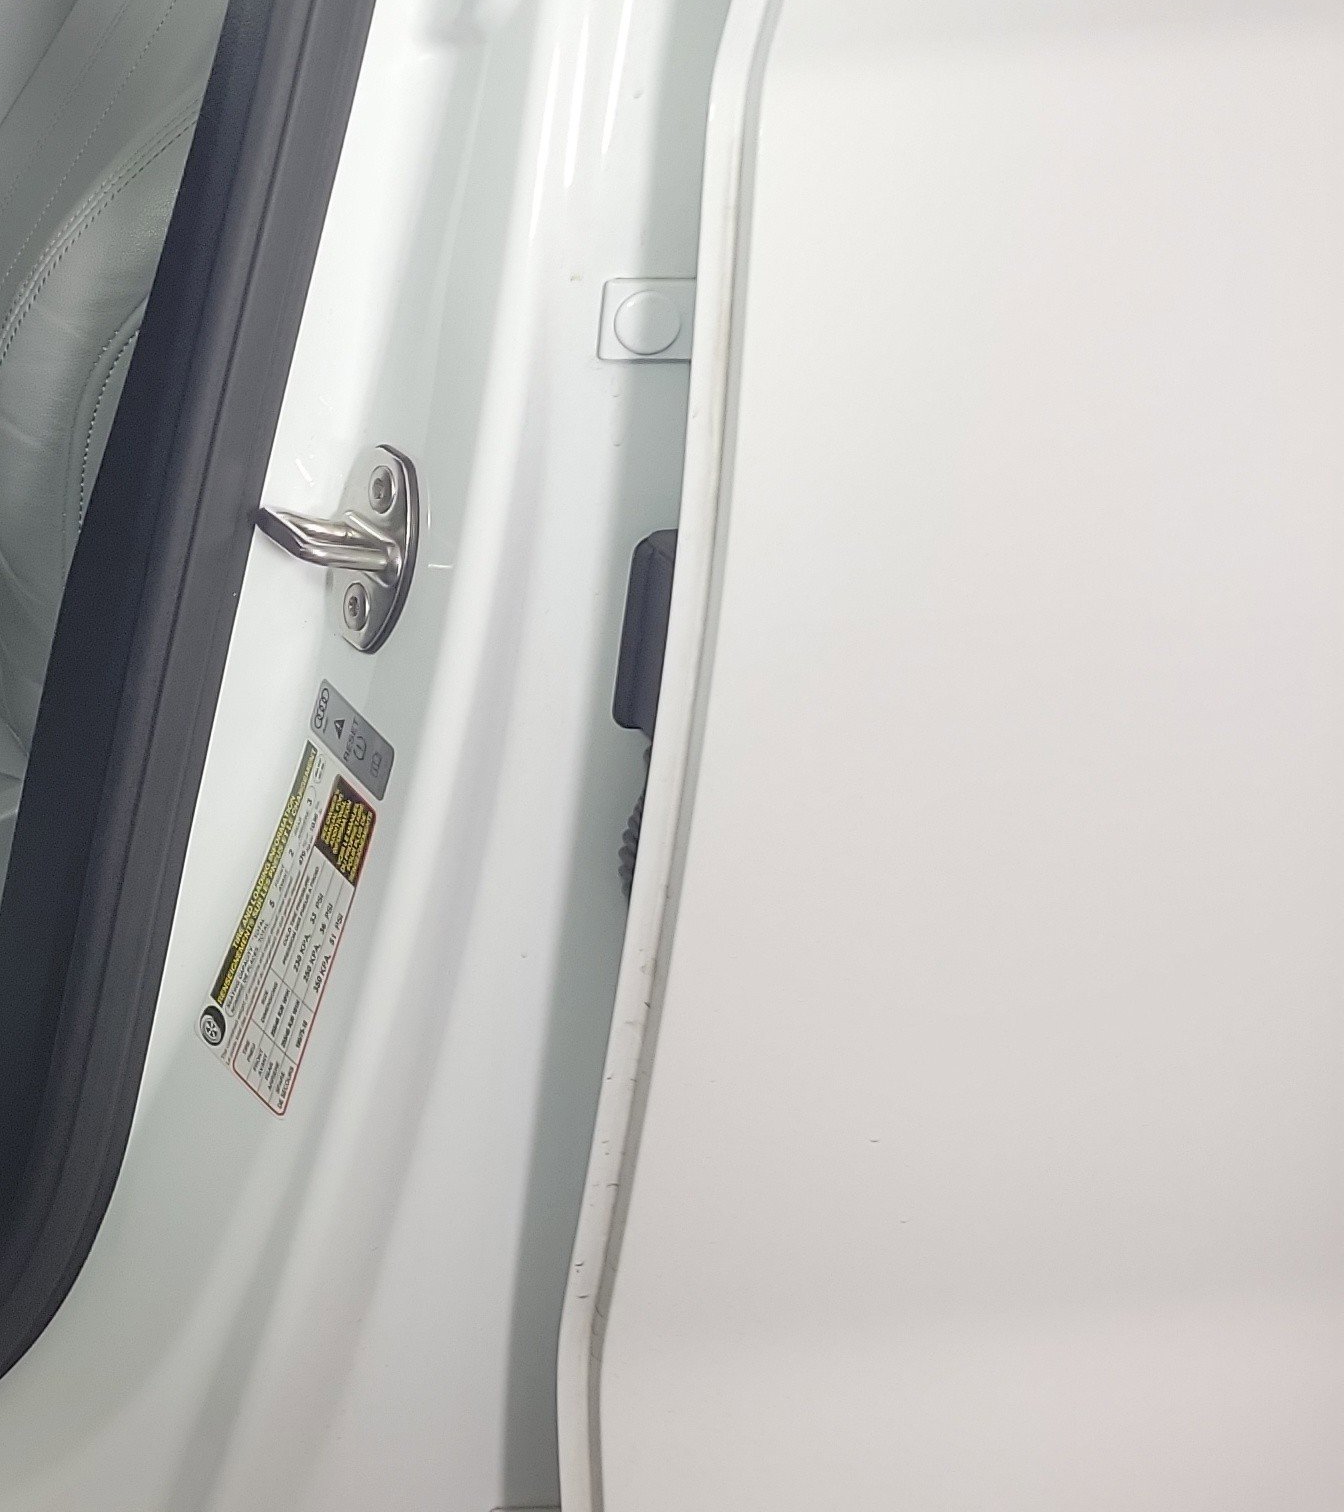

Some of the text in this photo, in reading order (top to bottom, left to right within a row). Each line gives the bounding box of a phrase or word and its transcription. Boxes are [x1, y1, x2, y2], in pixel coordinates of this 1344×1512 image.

[343, 717, 360, 761] RESET
[242, 903, 253, 926] AND
[250, 860, 270, 905] LOADING
[267, 795, 295, 861] INFORMATION
[251, 896, 262, 919] SUR
